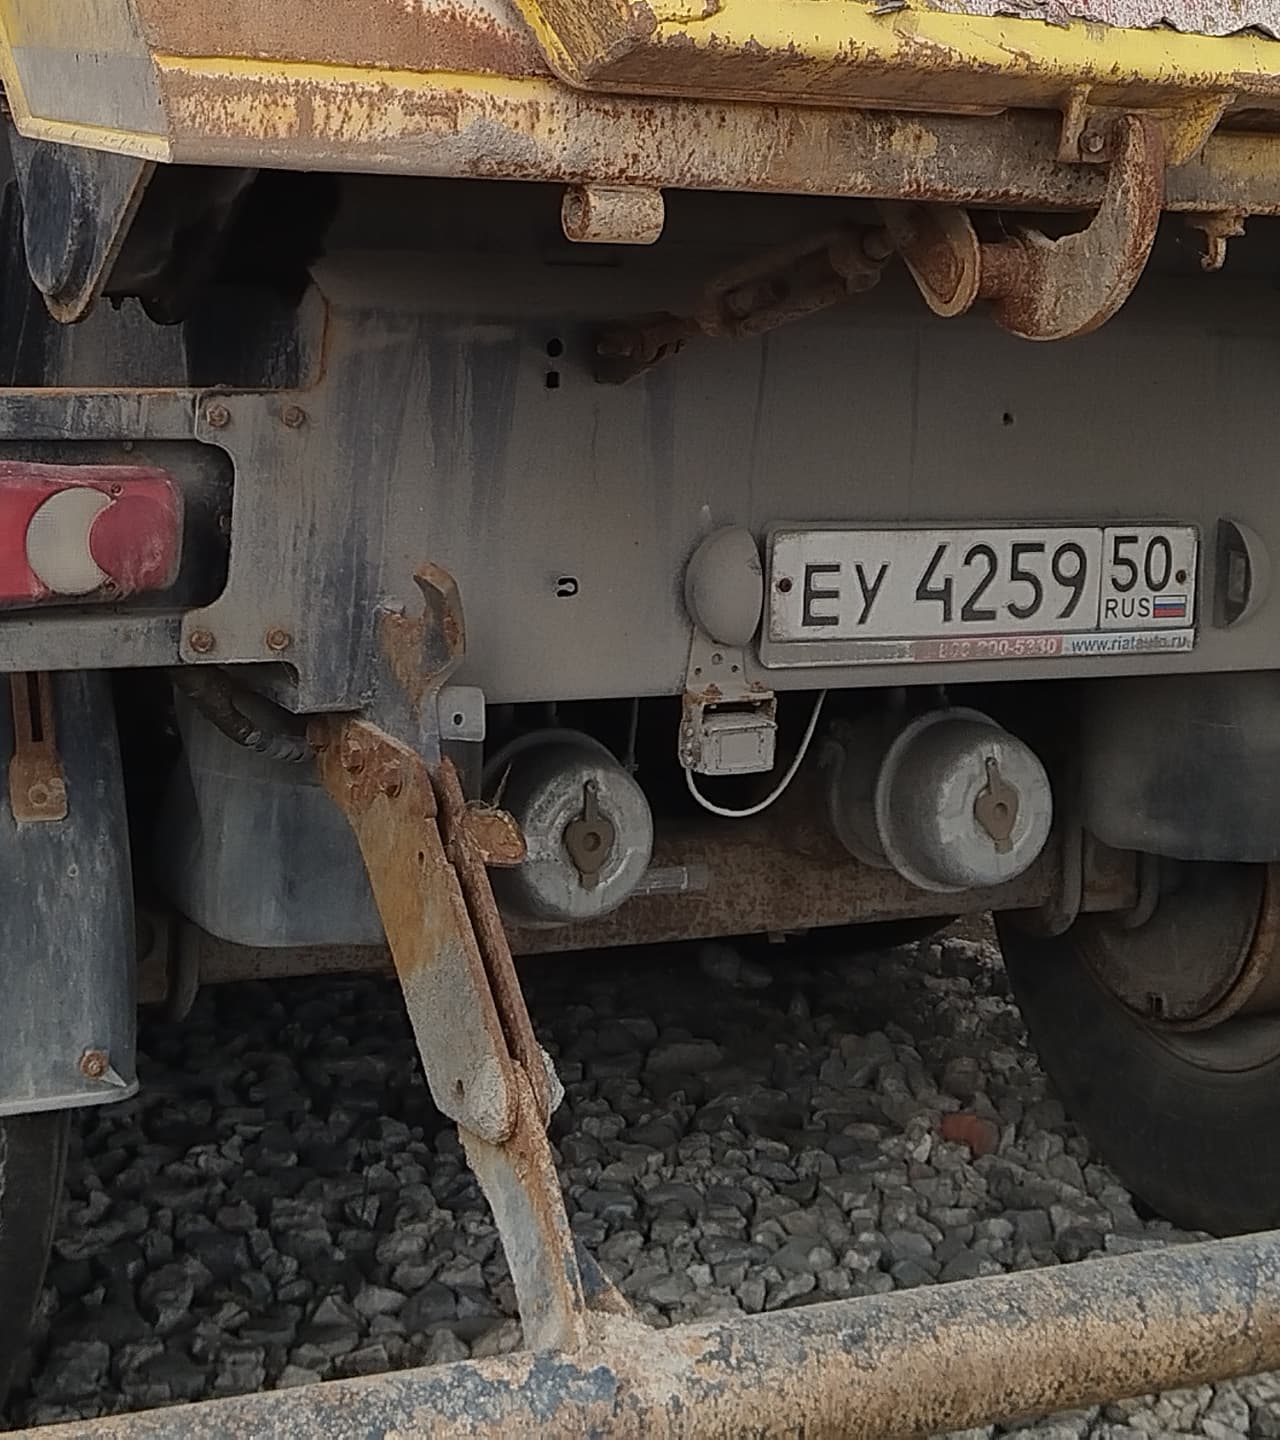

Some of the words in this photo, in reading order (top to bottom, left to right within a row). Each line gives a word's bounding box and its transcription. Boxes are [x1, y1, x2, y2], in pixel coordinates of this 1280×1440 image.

[914, 540, 1090, 624] 4259
[1110, 535, 1174, 593] 50
[1105, 597, 1152, 620] RUS
[1071, 634, 1188, 653] www.riatauto.ru
